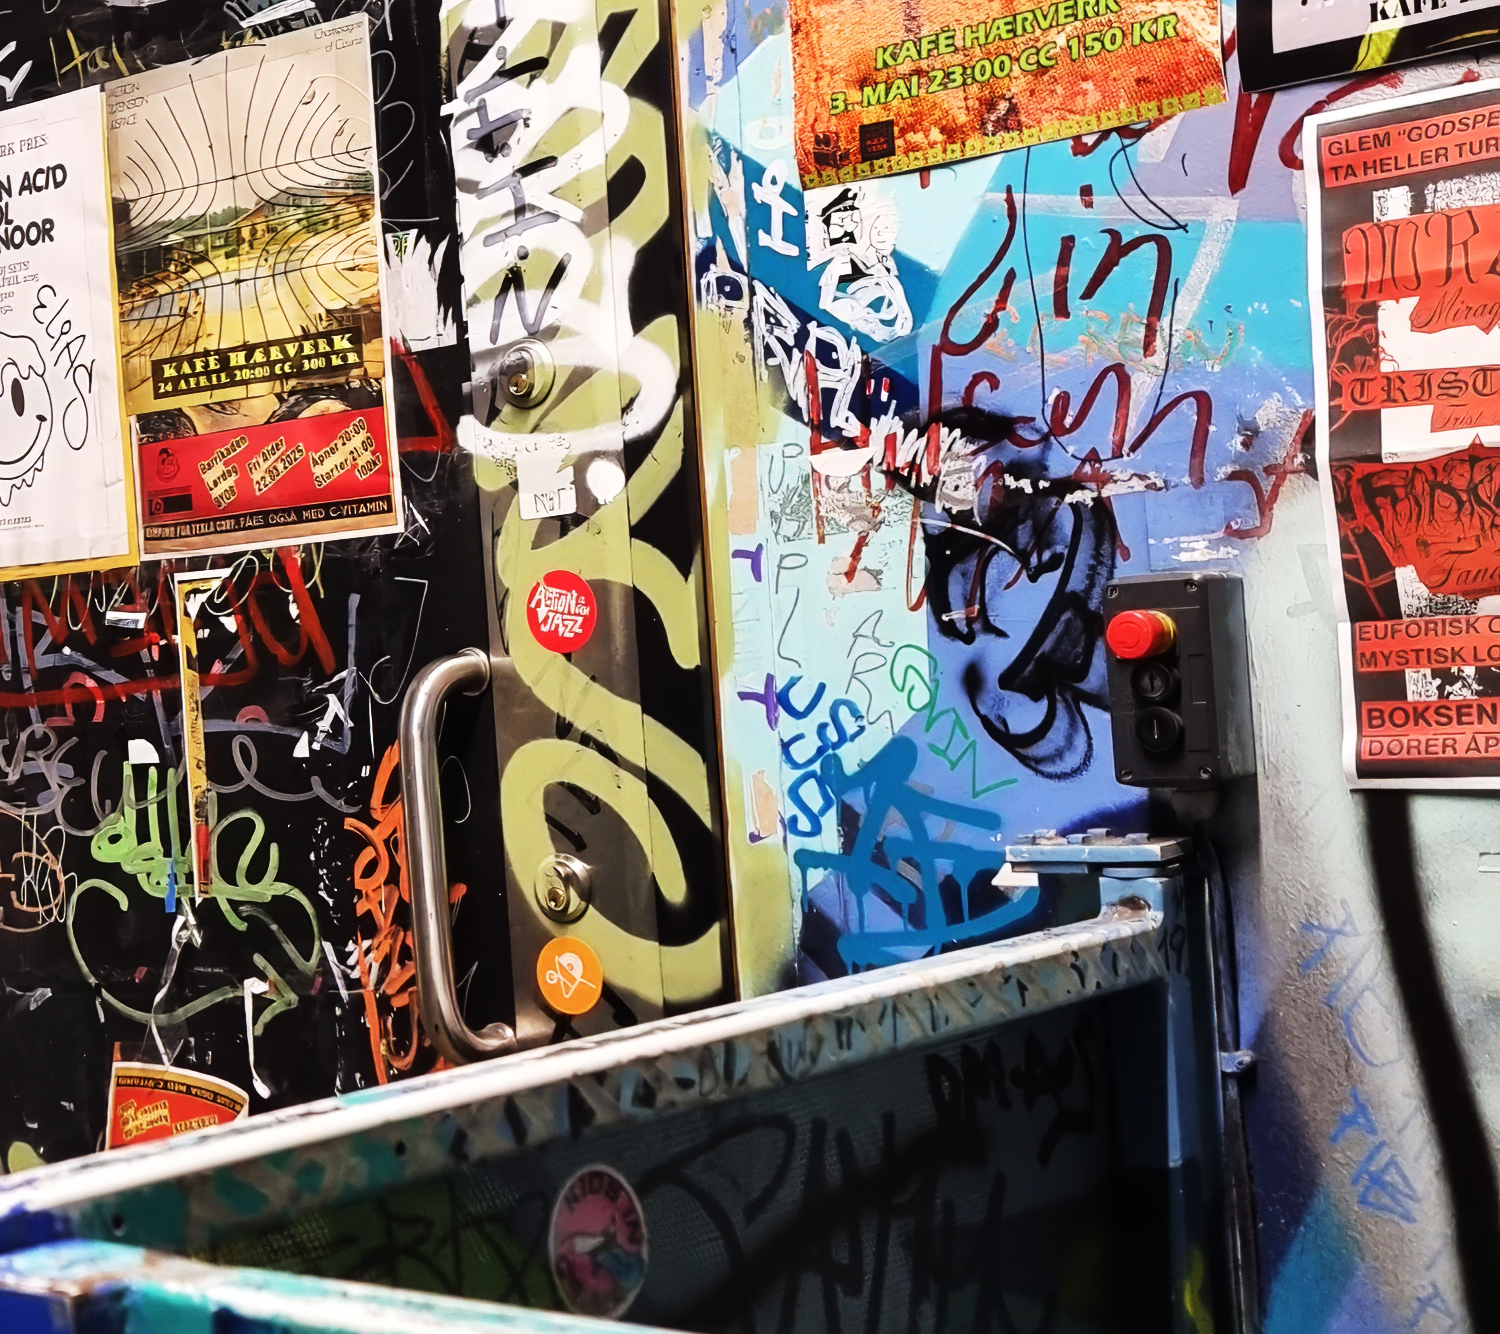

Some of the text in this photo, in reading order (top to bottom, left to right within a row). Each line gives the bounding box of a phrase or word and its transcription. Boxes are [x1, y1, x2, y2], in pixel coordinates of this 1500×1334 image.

[830, 14, 1178, 116] 3. MAI 23:00 CC 150 KR
[876, 28, 955, 69] KAFÉ
[1328, 131, 1391, 157] GLEM
[18, 163, 68, 197] ACID
[1330, 164, 1358, 182] TA
[1363, 146, 1449, 177] HELLER
[162, 333, 355, 380] KAFÉ HÆRVERK
[176, 374, 231, 392] APRIL
[302, 357, 327, 371] 300
[330, 351, 361, 367] KR
[1358, 617, 1480, 642] EUFORISK
[1360, 646, 1466, 667] MYSTISK
